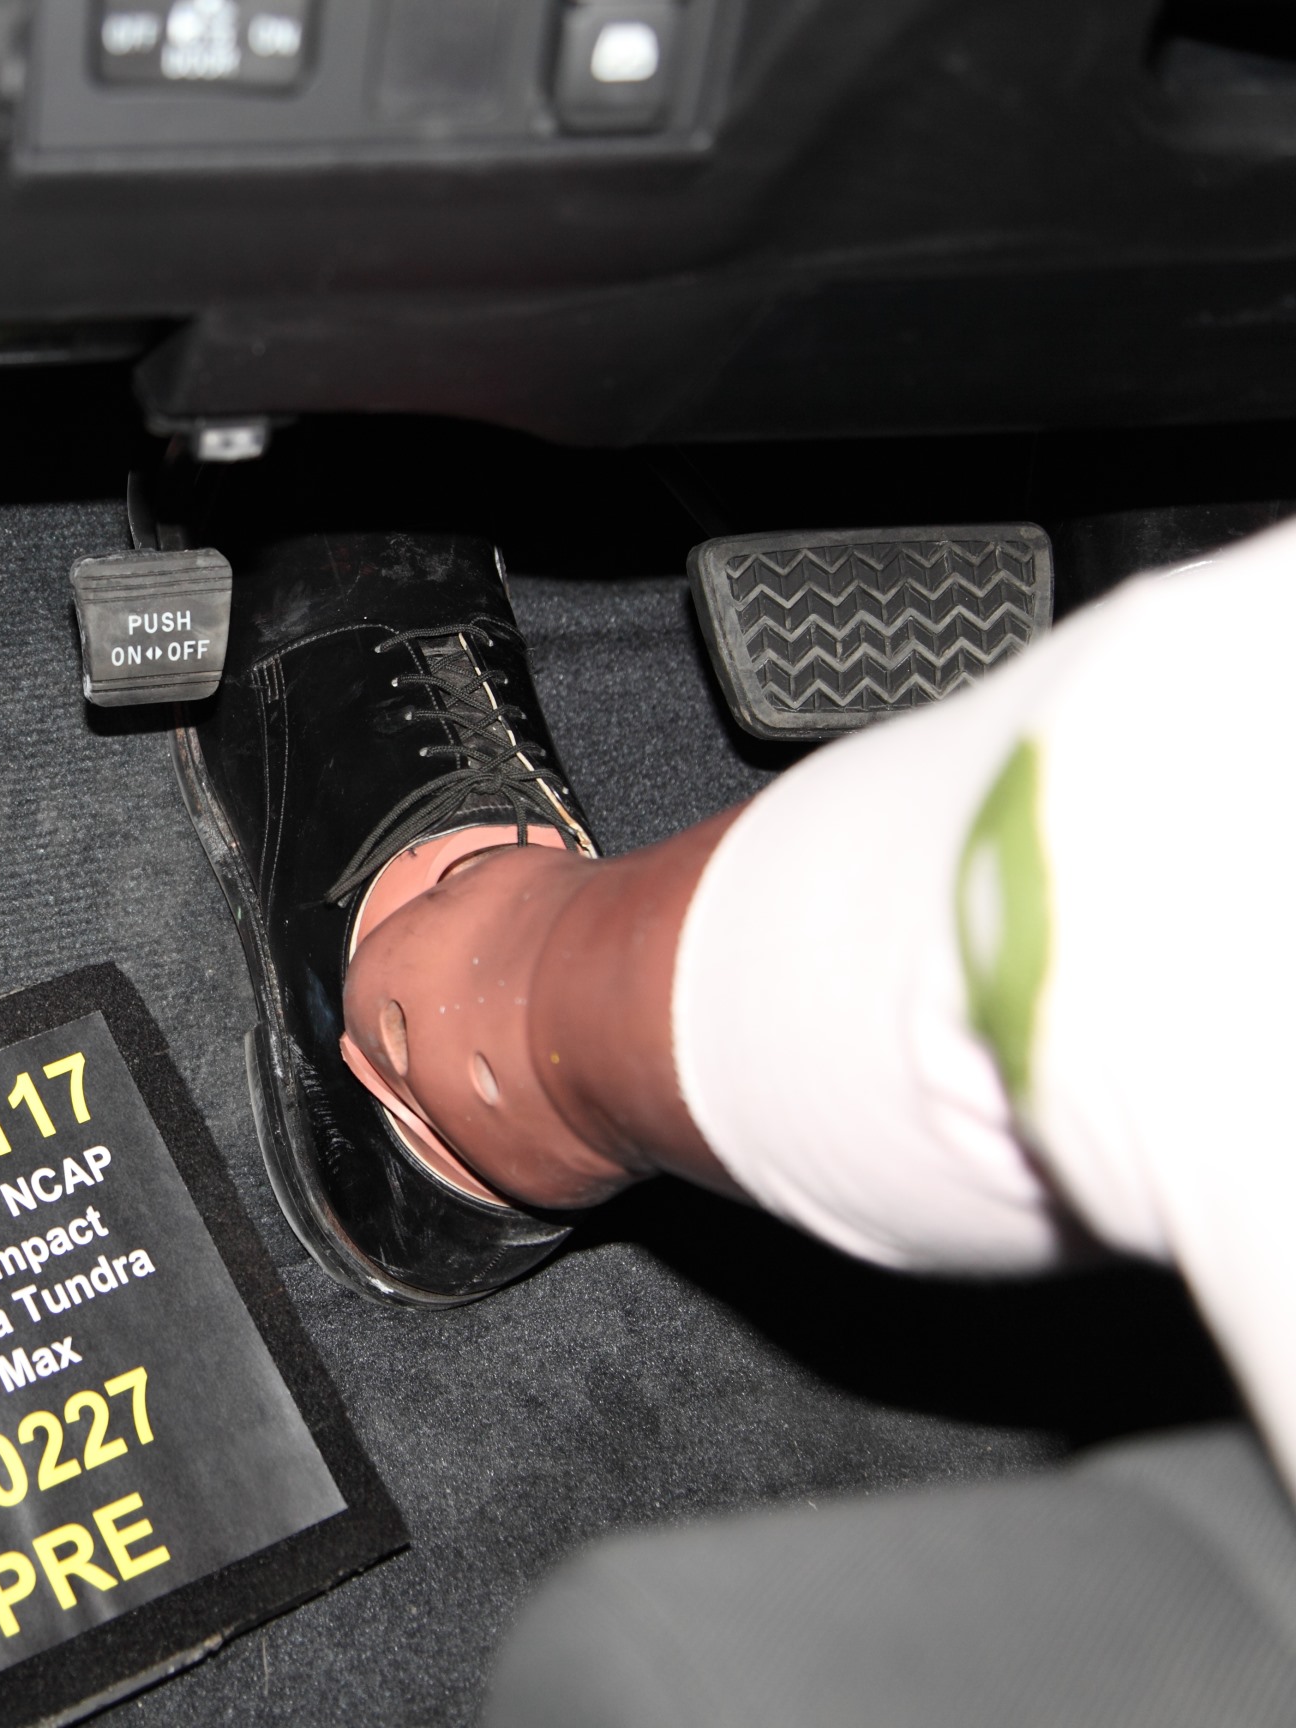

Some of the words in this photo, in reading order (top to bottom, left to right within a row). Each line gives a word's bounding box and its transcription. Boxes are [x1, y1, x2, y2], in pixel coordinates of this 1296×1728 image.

[128, 610, 191, 635] PUSH
[111, 646, 141, 667] ON
[168, 640, 210, 661] OFF
[0, 1144, 112, 1217] NCAP
[12, 1247, 155, 1323] Tundra
